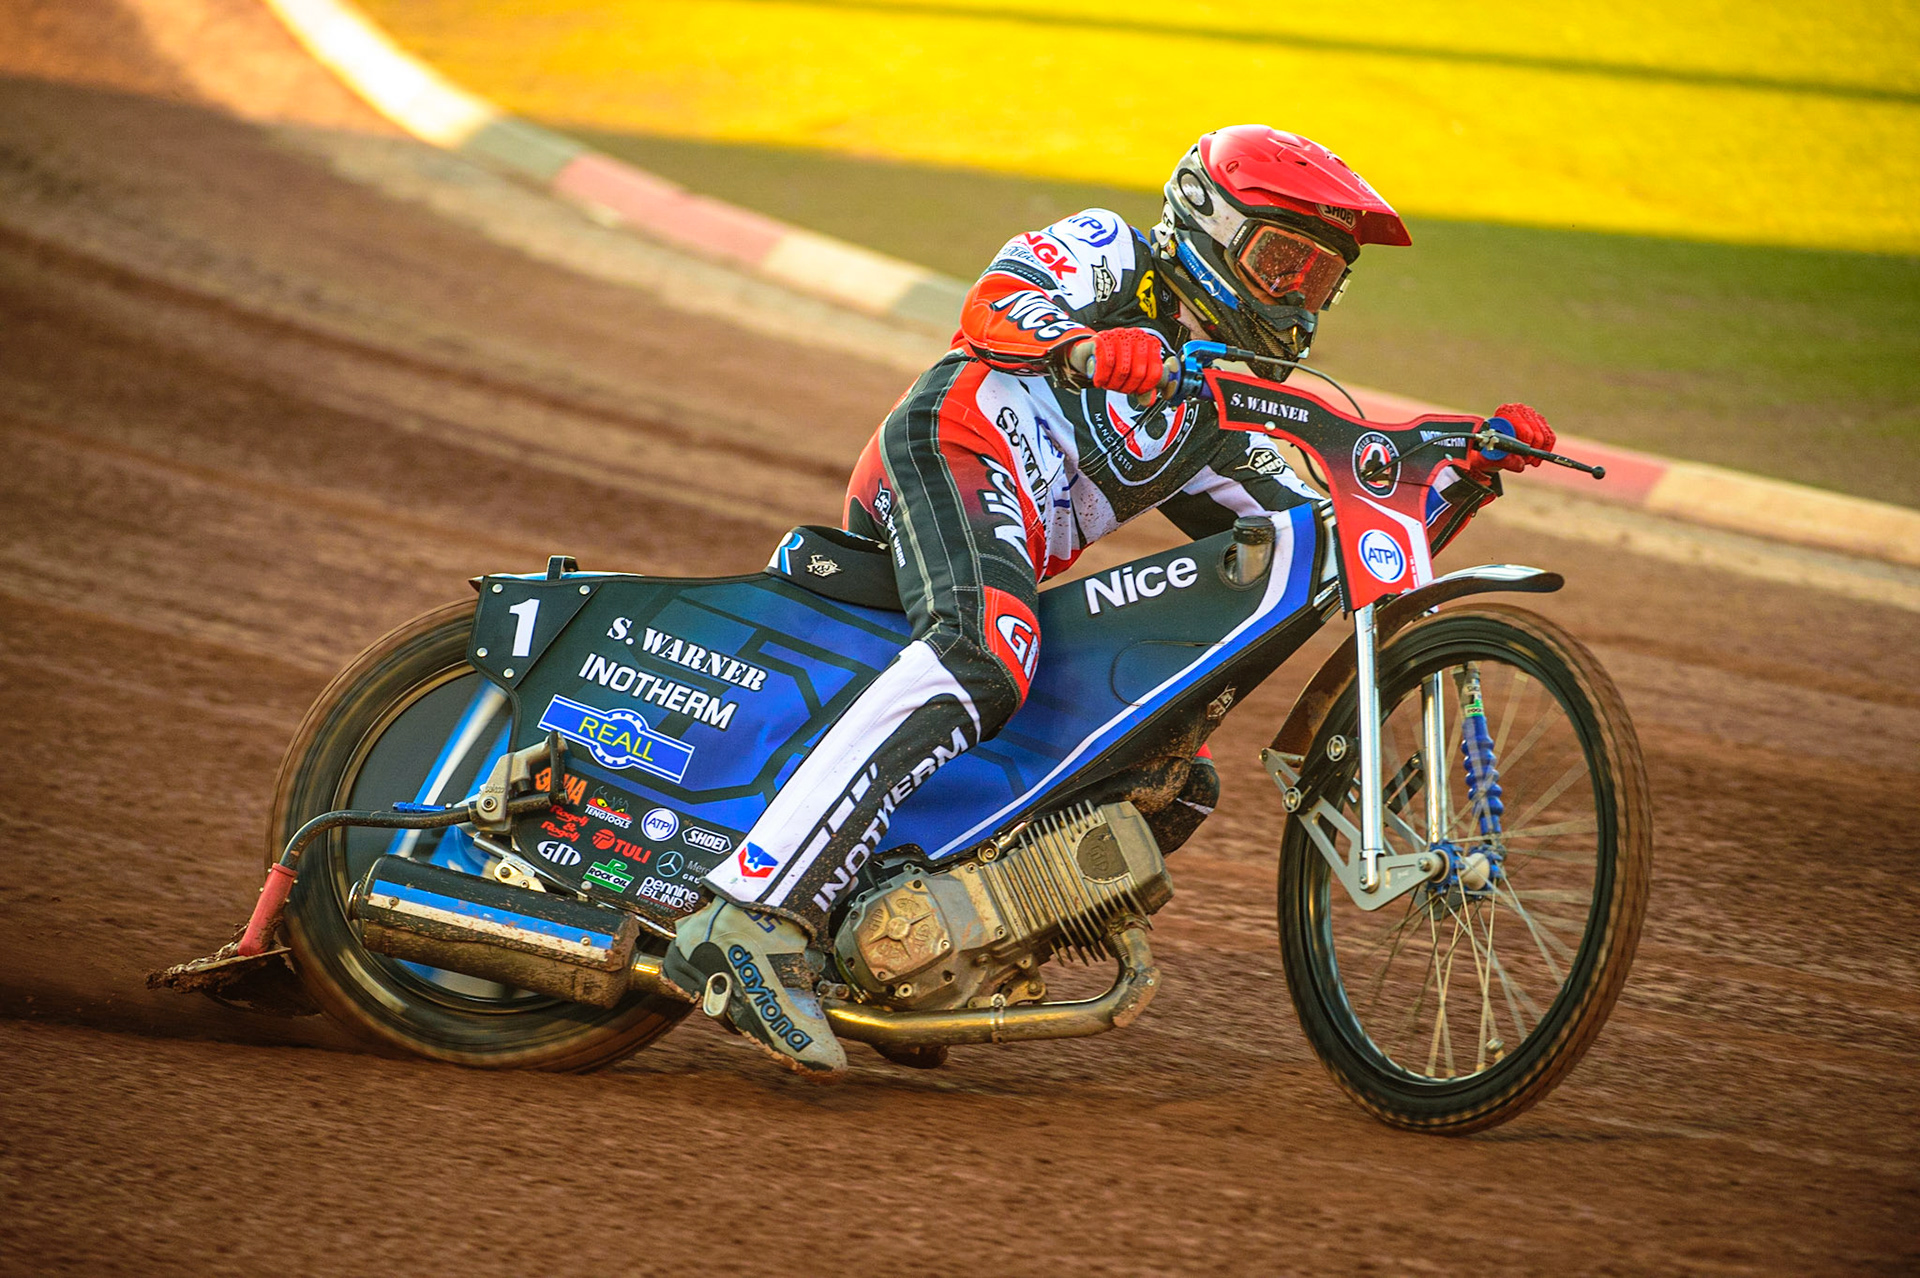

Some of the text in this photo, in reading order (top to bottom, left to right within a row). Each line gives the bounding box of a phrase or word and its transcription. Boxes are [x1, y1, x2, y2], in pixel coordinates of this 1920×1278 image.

[1324, 205, 1354, 227] SHOEI
[1229, 392, 1309, 423] S. WARNER
[1368, 546, 1398, 567] ATPI
[1084, 556, 1198, 615] Nice
[508, 597, 541, 657] 1
[606, 616, 768, 692] S. WARNER
[578, 652, 738, 730] INOTHERM
[578, 715, 655, 763] REALL
[583, 804, 633, 829] TENGTOOLS
[646, 816, 672, 833] ATPI
[812, 726, 969, 913] INOTHERM
[614, 838, 652, 864] TULI
[687, 830, 727, 852] SHOEI
[587, 866, 630, 889] ROCK OIL
[636, 876, 699, 904] pennine
[640, 887, 694, 913] BLINDS
[728, 943, 814, 1053] daytona
